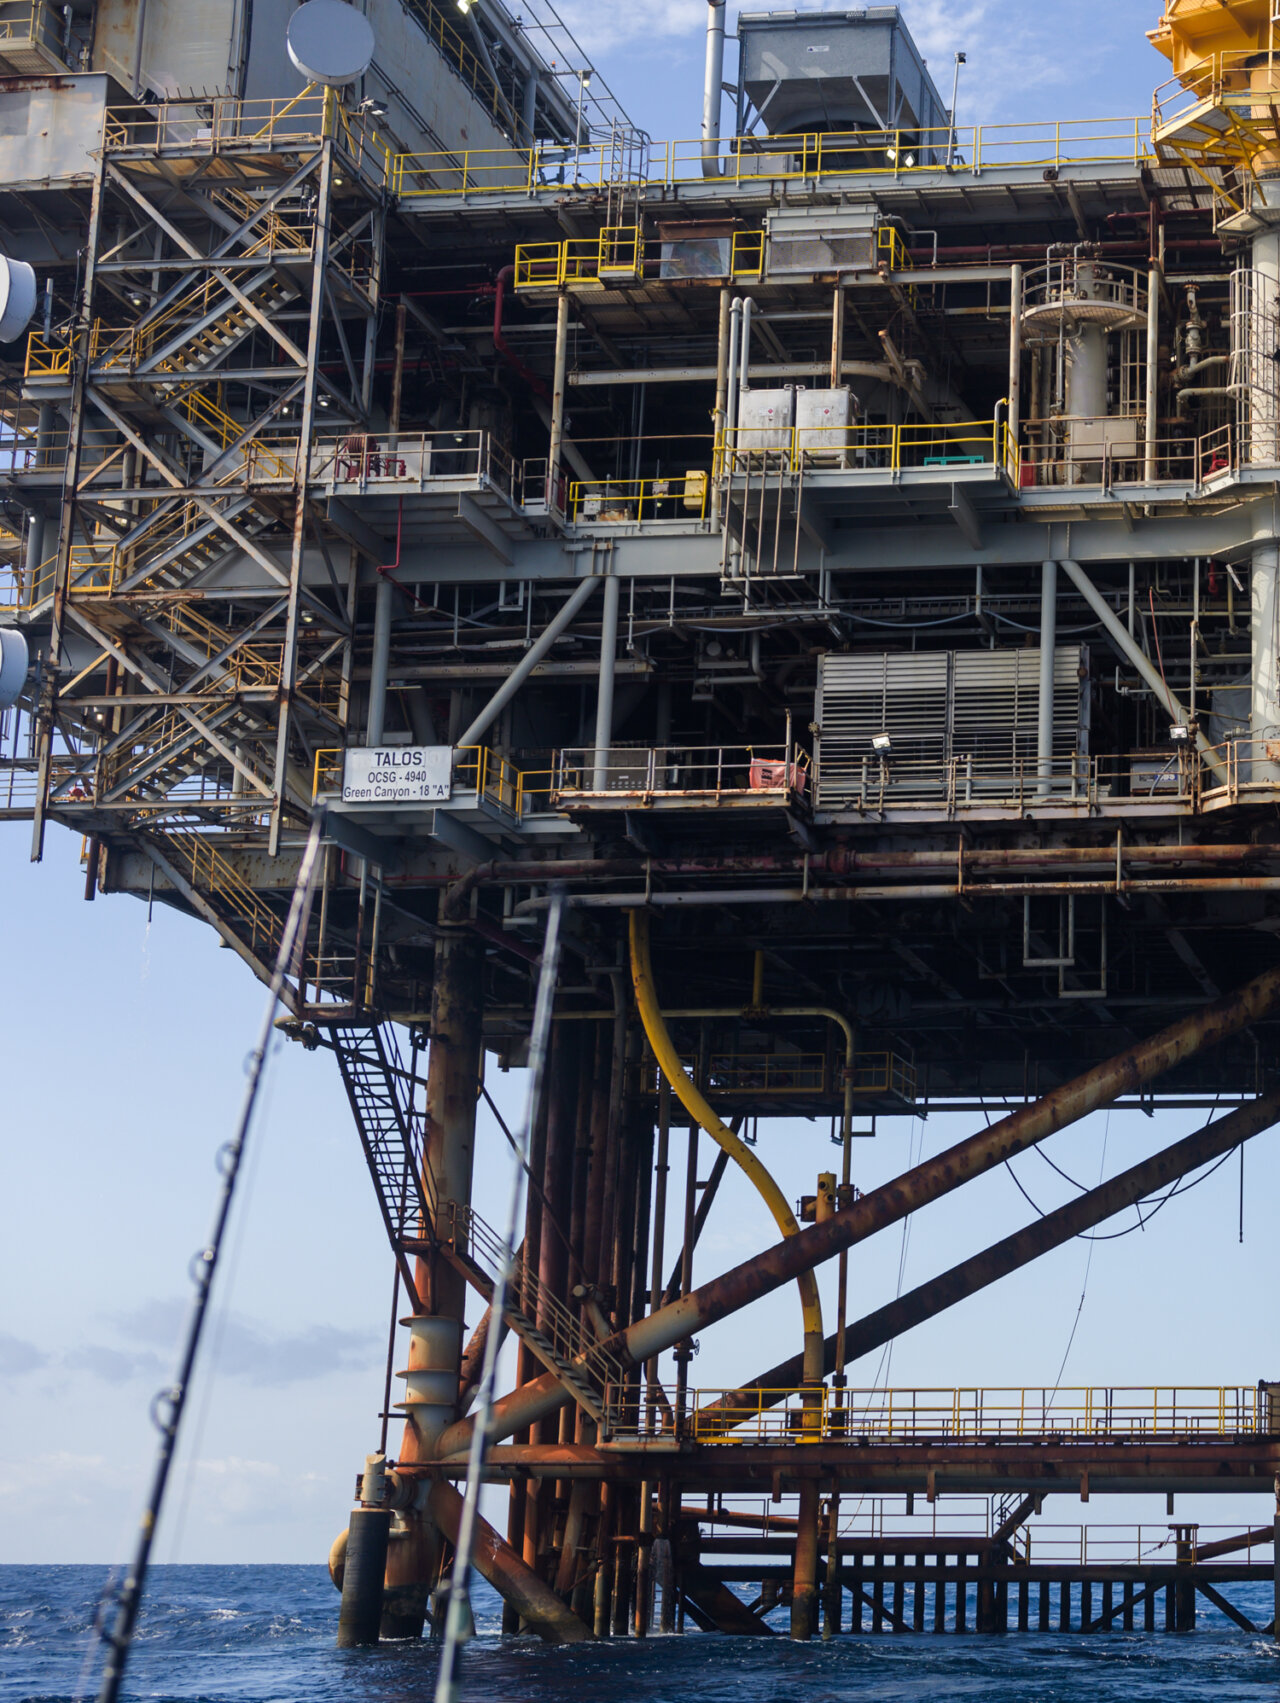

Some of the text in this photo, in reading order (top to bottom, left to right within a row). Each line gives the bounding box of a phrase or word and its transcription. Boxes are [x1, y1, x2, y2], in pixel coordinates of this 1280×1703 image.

[375, 751, 423, 766] TALOS
[368, 771, 397, 784] OCSG
[404, 770, 427, 783] 4940
[344, 786, 372, 798] Green
[374, 785, 410, 800] Canyon
[419, 784, 430, 797] 18
[432, 784, 450, 797] "A"
